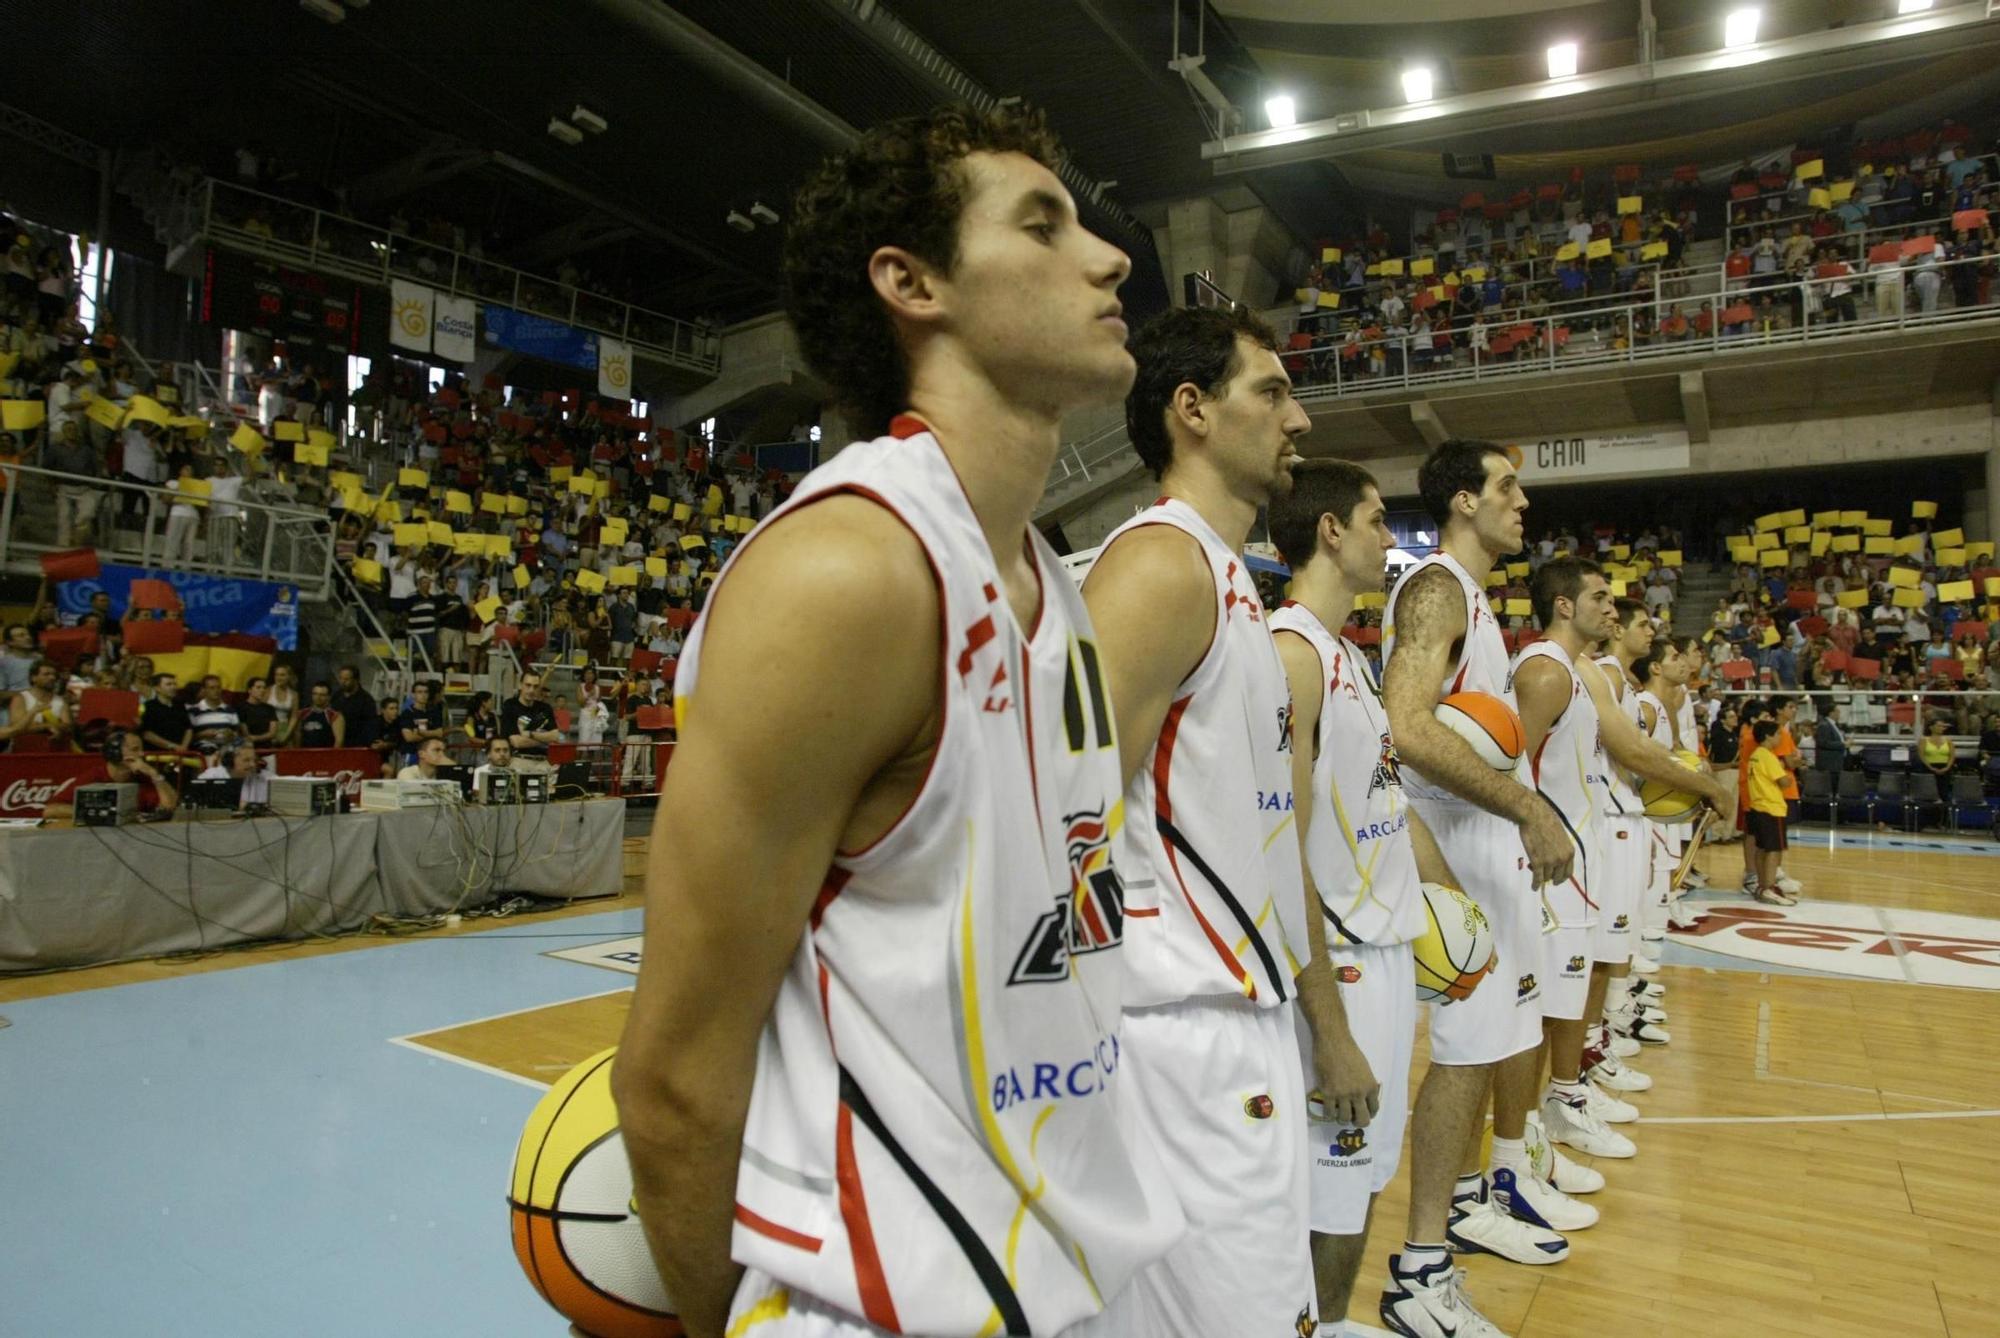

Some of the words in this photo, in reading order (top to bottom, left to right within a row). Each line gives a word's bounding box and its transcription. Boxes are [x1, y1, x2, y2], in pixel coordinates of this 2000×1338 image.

[436, 322, 474, 340] Blanca
[443, 315, 474, 331] Costa
[1537, 438, 1585, 468] CAM
[1317, 1158, 1348, 1168] FUERZAS
